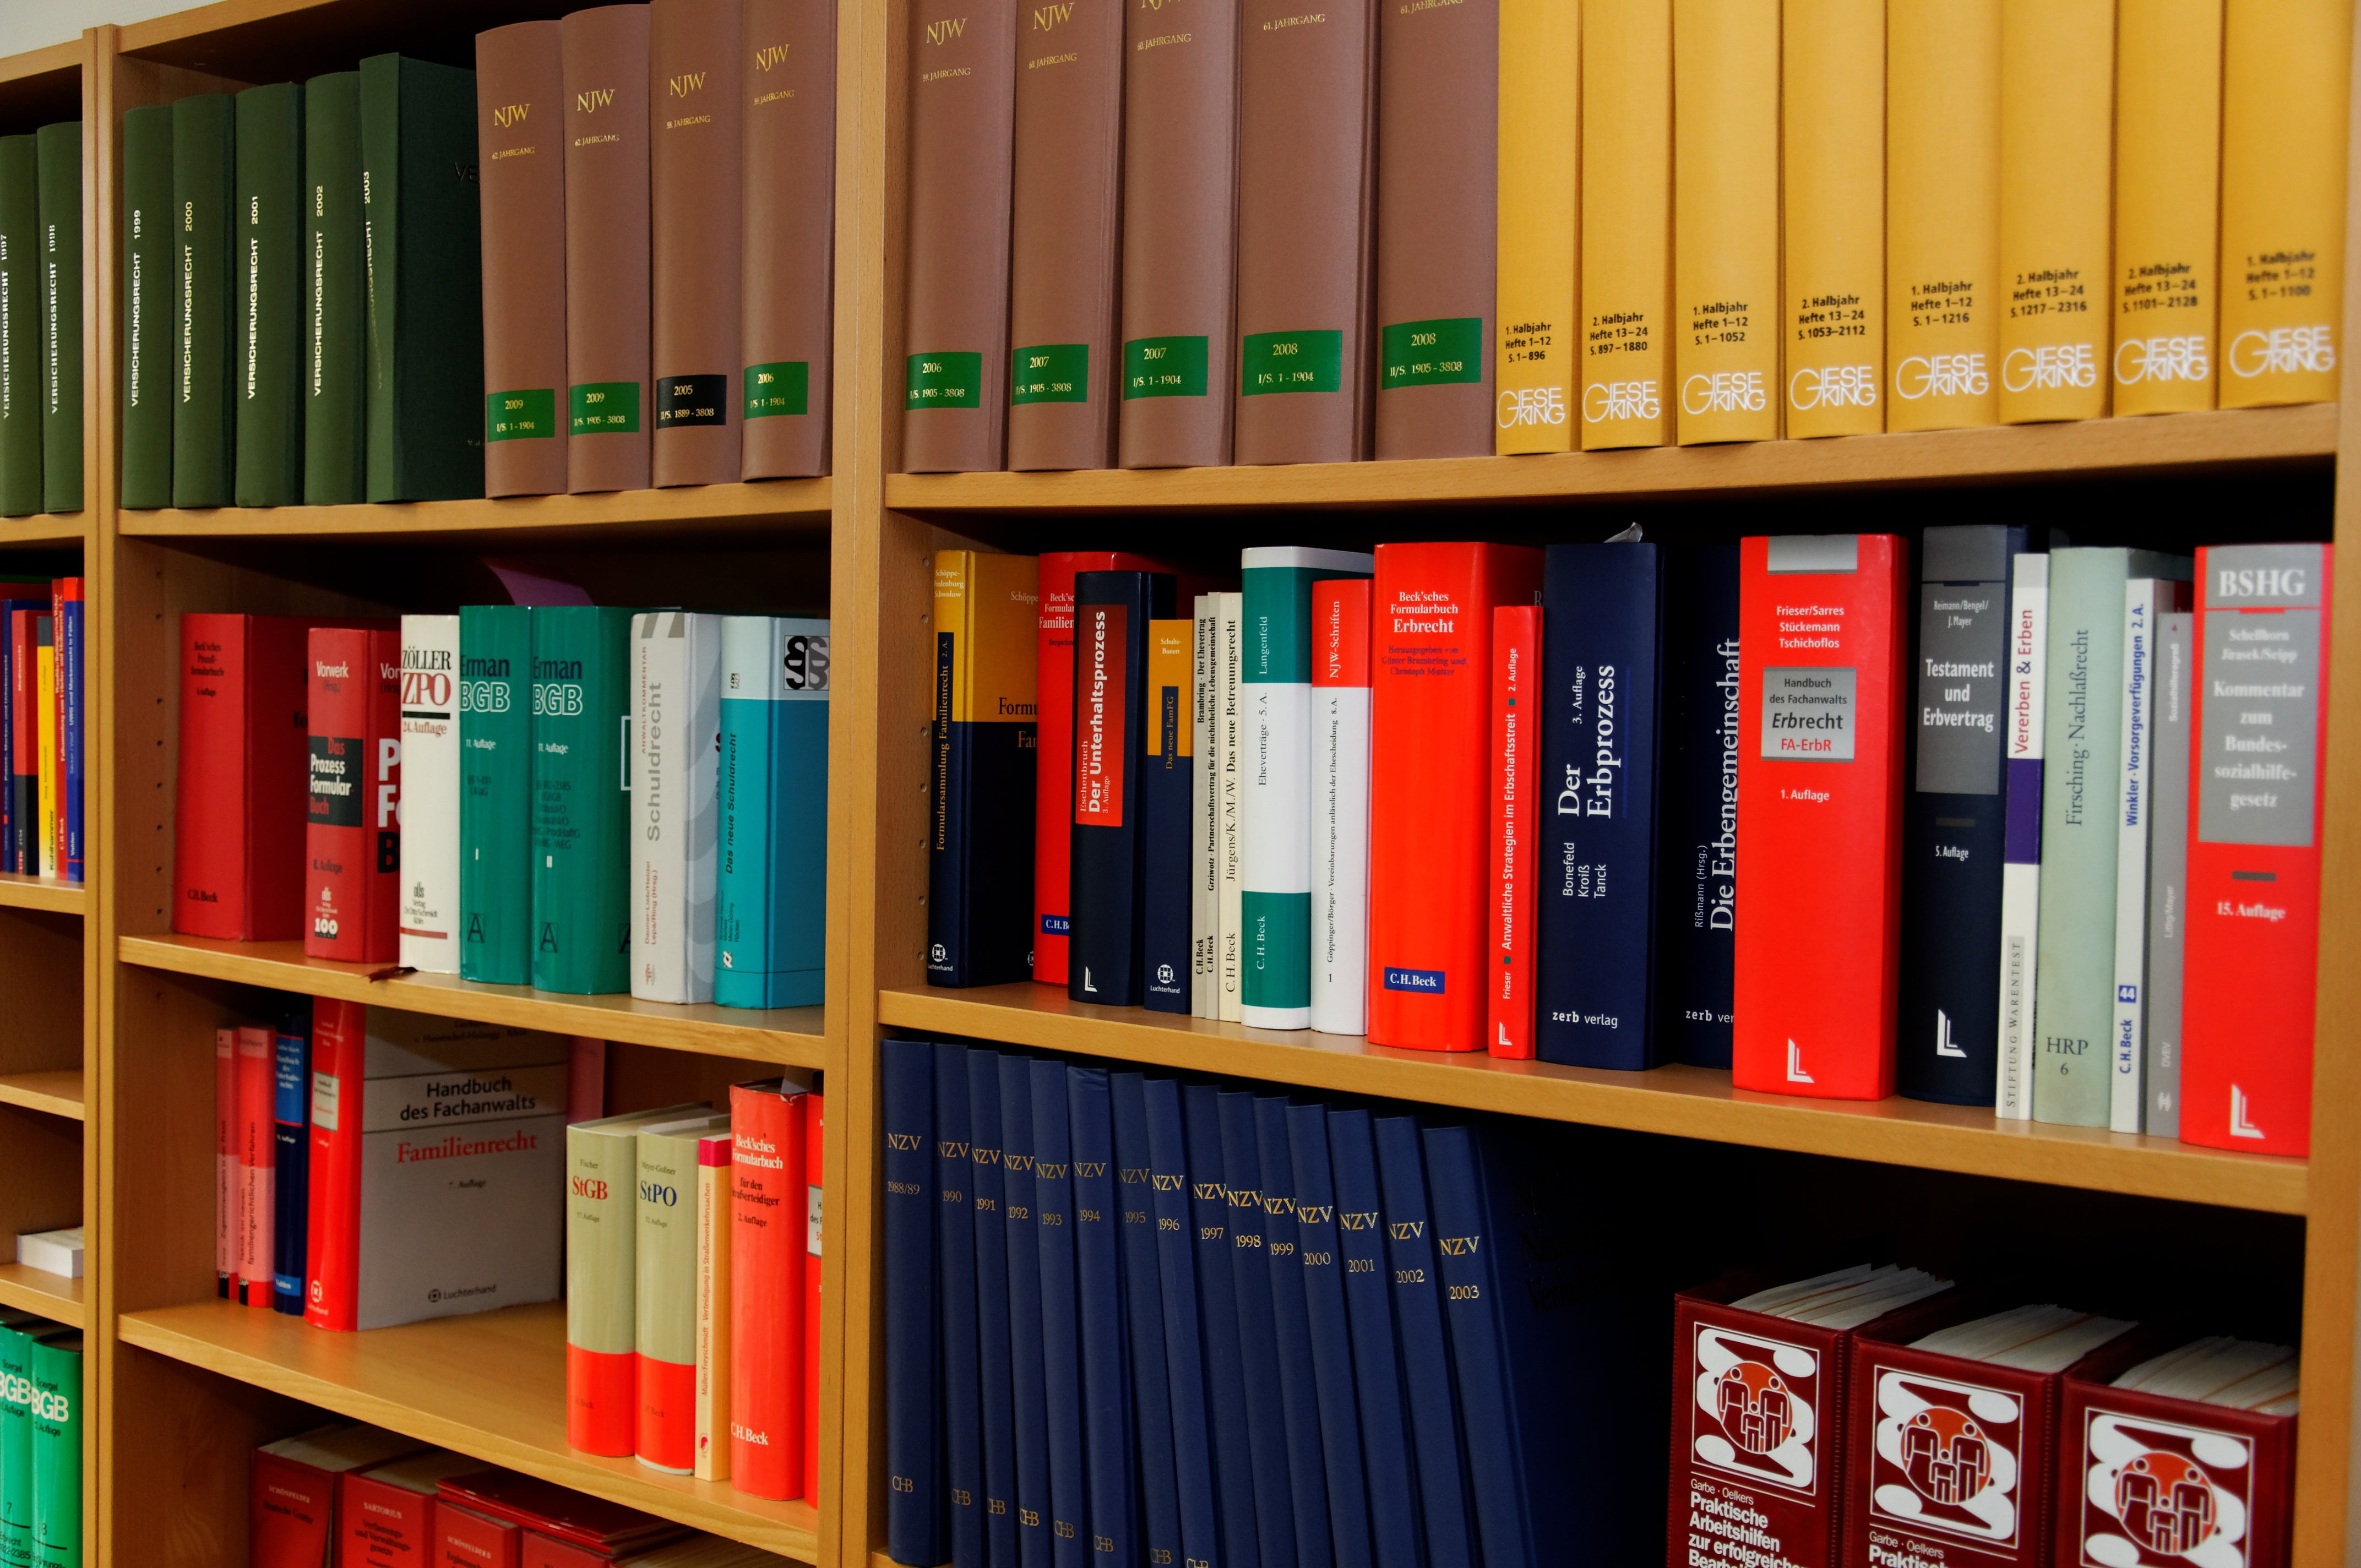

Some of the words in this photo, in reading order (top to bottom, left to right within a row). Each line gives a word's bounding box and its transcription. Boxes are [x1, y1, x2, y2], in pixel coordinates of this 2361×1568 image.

[1033, 2, 1074, 31] NJW
[1264, 22, 1272, 30] 61.
[1275, 14, 1325, 30] JAHRGANG
[927, 18, 967, 45] NJW
[757, 44, 789, 72] NJW
[670, 72, 706, 97] NJW
[577, 89, 615, 113] NJW
[494, 104, 530, 127] NJW
[674, 115, 710, 128] JAHRGANG
[1703, 302, 1748, 314] Halbjahr
[1813, 295, 1859, 307] Halbjahr
[184, 245, 192, 402] VERSICHERUNGSRECHT
[248, 238, 258, 399] VERSICHERUNGSRECHT
[314, 231, 323, 396] VERSICHERUNGSRECHT
[1694, 319, 1718, 330] Hefte
[1799, 313, 1825, 324] Hefte
[1273, 344, 1297, 355] 2008
[1411, 333, 1436, 346] 2008
[1030, 357, 1049, 368] 2007
[1144, 348, 1167, 360] 2007
[758, 373, 774, 384] 2006
[923, 363, 942, 373] 2006
[586, 393, 605, 403] 2009
[674, 385, 693, 395] 2005
[505, 400, 523, 410] 2009
[2219, 569, 2305, 596] BSHG
[1391, 604, 1458, 613] Formularbuch
[1777, 606, 1844, 615] Frieser/Sarres
[1394, 619, 1453, 633] Erbrecht
[1780, 622, 1840, 631] Stückemann
[2019, 611, 2032, 655] Erben
[1198, 619, 1206, 658] Ehevertrag
[1259, 617, 1269, 674] Langenfeld
[1330, 601, 1341, 677] NJW-Schriften
[1780, 638, 1840, 647] Tschichoflos
[401, 646, 451, 670] ZÖLLER
[1209, 617, 1217, 693] Lebensgemeinschaft
[1508, 649, 1518, 681] Auflage
[317, 661, 349, 678] Vorwerk
[1227, 621, 1237, 715] Betreuungsrecht
[1925, 658, 1994, 677] Testament
[2017, 662, 2030, 674] &
[401, 673, 450, 706] ZPO
[1090, 612, 1107, 774] Unterhaltsprozess
[1572, 666, 1586, 710] Auflage
[1785, 678, 1831, 688] Handbuch
[1945, 684, 1970, 701] und
[2069, 630, 2088, 739] Nachlaßrecht
[2213, 681, 2305, 697] Kommentar
[460, 681, 510, 712] BGB
[533, 684, 583, 716] BGB
[939, 665, 948, 739] Familienrecht
[1770, 694, 1785, 703] des
[1788, 694, 1847, 704] Fachanwalts
[2128, 636, 2144, 770] Vorsorgeverfügungen
[1573, 714, 1582, 724] 3.
[1772, 712, 1843, 729] Erbrecht
[1923, 707, 1994, 732] Erbvertrag
[2016, 682, 2030, 752] Vererben
[1330, 720, 1338, 772] Ehescheidung
[1586, 666, 1621, 819] Erbprozess
[1781, 738, 1831, 751] FA-ErbR
[648, 683, 661, 841] Schuldrecht
[1227, 751, 1236, 772] Das
[1259, 724, 1269, 786] Eheverträge
[1504, 714, 1515, 800] Erbschaftsstreit
[1711, 638, 1740, 877] Erbengemeinschaft
[937, 743, 949, 850] Formularsammlung
[1089, 781, 1100, 812] Der
[1558, 764, 1580, 816] Der
[1791, 790, 1830, 803] Auflage
[2066, 750, 2090, 825] Firsching
[1504, 805, 1514, 818] im
[2127, 780, 2138, 825] Winkler
[1503, 821, 1516, 880] Strategien
[1943, 846, 1968, 861] Auflage
[1563, 843, 1574, 896] Bonefeld
[1696, 846, 1707, 879] (Hrsg.)
[1578, 865, 1590, 897] Kroiß
[1594, 864, 1606, 899] Tanck
[1502, 883, 1513, 950] Anwaltliche
[1695, 884, 1704, 927] Rißmann
[1711, 885, 1736, 931] Die
[2237, 904, 2286, 921] Auflage
[315, 918, 338, 934] 100
[2009, 943, 2020, 1027] WARENTEST
[1553, 1011, 1579, 1022] zerb
[1585, 1014, 1618, 1028] verlag
[2047, 1037, 2088, 1055] HRP
[2006, 1036, 2017, 1107] STIFTUNG
[2060, 1063, 2068, 1075] 6
[427, 1075, 512, 1097] Handbuch
[400, 1104, 428, 1120] des
[434, 1096, 535, 1117] Fachanwalts
[397, 1130, 537, 1163] Familienrecht
[888, 1133, 921, 1150] NZV
[972, 1148, 1000, 1164] NZV
[1004, 1154, 1034, 1170] NZV
[1074, 1162, 1106, 1177] NZV
[574, 1178, 607, 1200] StGB
[641, 1180, 677, 1206] StPO
[888, 1181, 920, 1194] 1988/89
[1152, 1175, 1184, 1190] NZV
[977, 1198, 995, 1210] 1991
[1227, 1191, 1263, 1207] NZV
[1009, 1206, 1027, 1219] 1992
[1080, 1210, 1100, 1221] 1994
[1297, 1206, 1332, 1223] NZV
[1158, 1218, 1179, 1230] 1996
[1236, 1235, 1261, 1247] 1998
[1439, 1236, 1479, 1255] NZV
[1304, 1253, 1330, 1265] 2000
[1450, 1285, 1479, 1299] 2003
[1691, 1479, 1715, 1494] Garbe
[1722, 1488, 1754, 1506] Oelkers
[1689, 1491, 1769, 1529] Praktische
[1689, 1511, 1780, 1553] Arbeitshilfen
[1689, 1533, 1710, 1550] zur
